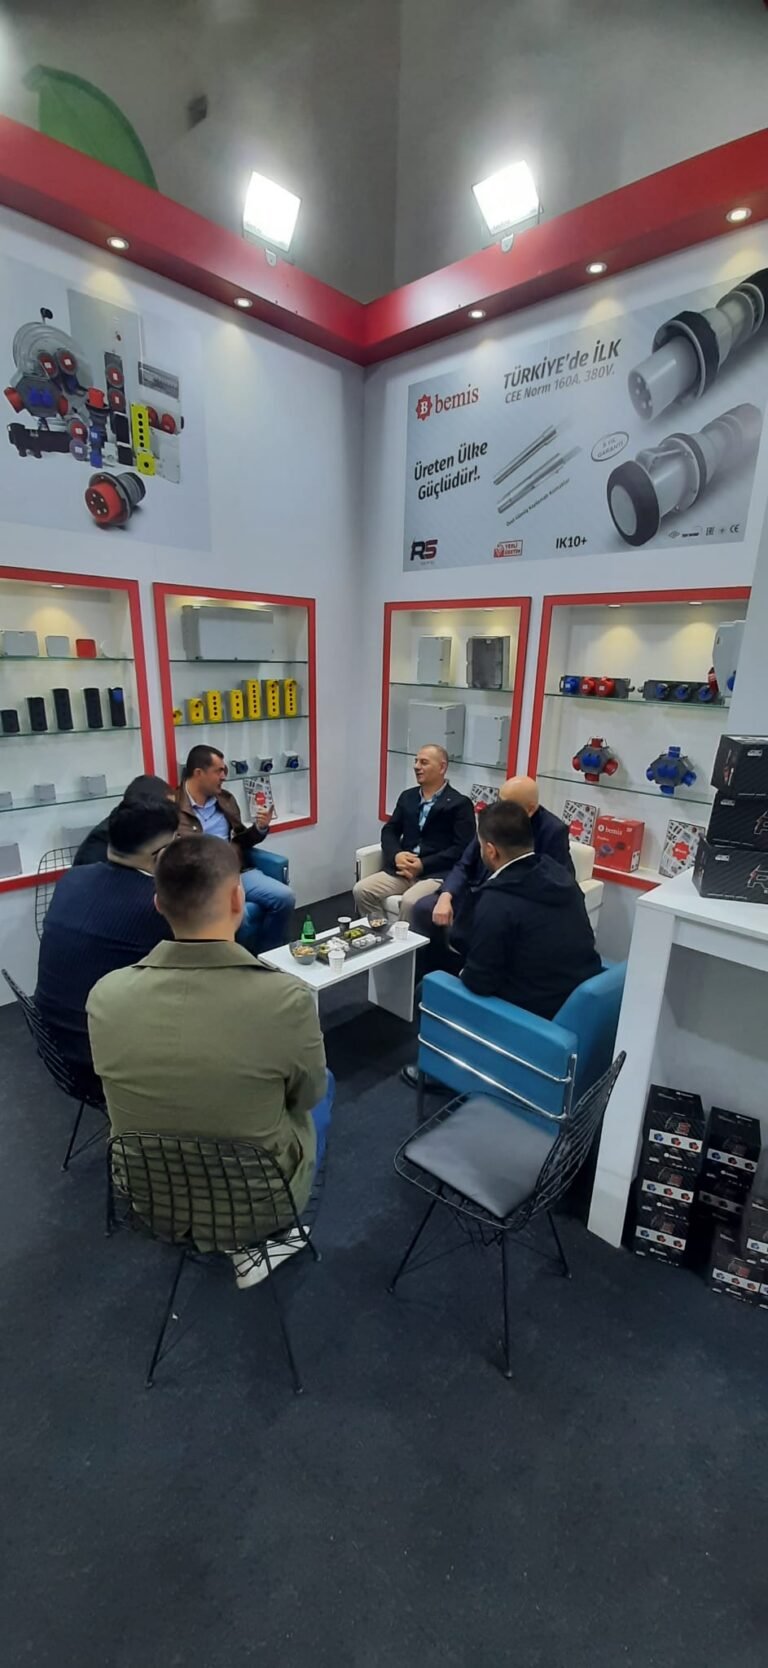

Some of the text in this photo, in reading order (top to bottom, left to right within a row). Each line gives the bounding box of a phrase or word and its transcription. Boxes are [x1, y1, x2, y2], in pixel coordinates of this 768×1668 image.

[504, 339, 622, 389] TÜRKİYE'de İLK
[435, 383, 479, 414] bemis
[505, 389, 522, 404] CEE
[524, 383, 551, 399] Norm
[584, 363, 615, 382] 380V.
[414, 442, 488, 481] Üreten Ülke
[418, 465, 481, 500] Güçlüdür!.
[555, 535, 588, 549] IK10+
